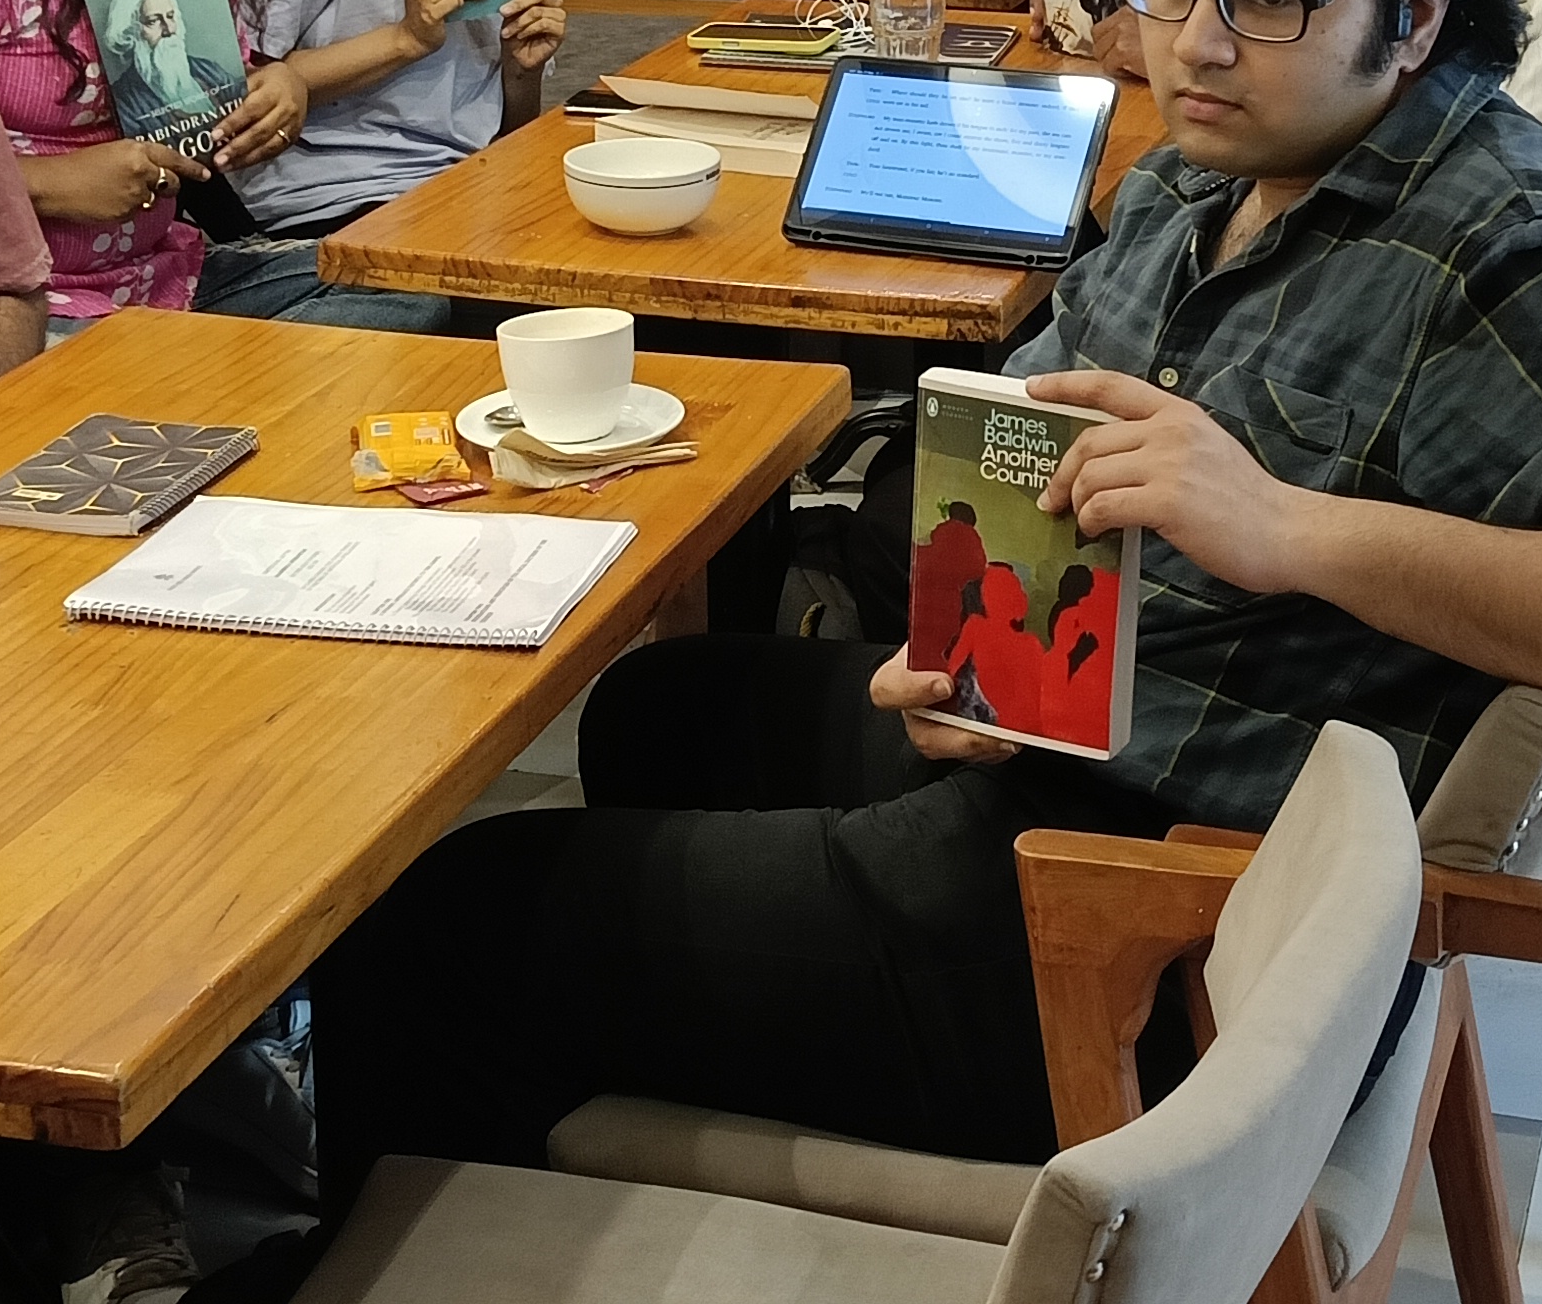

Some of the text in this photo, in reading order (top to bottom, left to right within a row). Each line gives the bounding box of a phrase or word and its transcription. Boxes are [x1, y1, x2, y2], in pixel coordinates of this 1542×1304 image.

[984, 408, 1047, 436] James
[984, 425, 1058, 455] Baldwin
[981, 443, 1058, 473] Another
